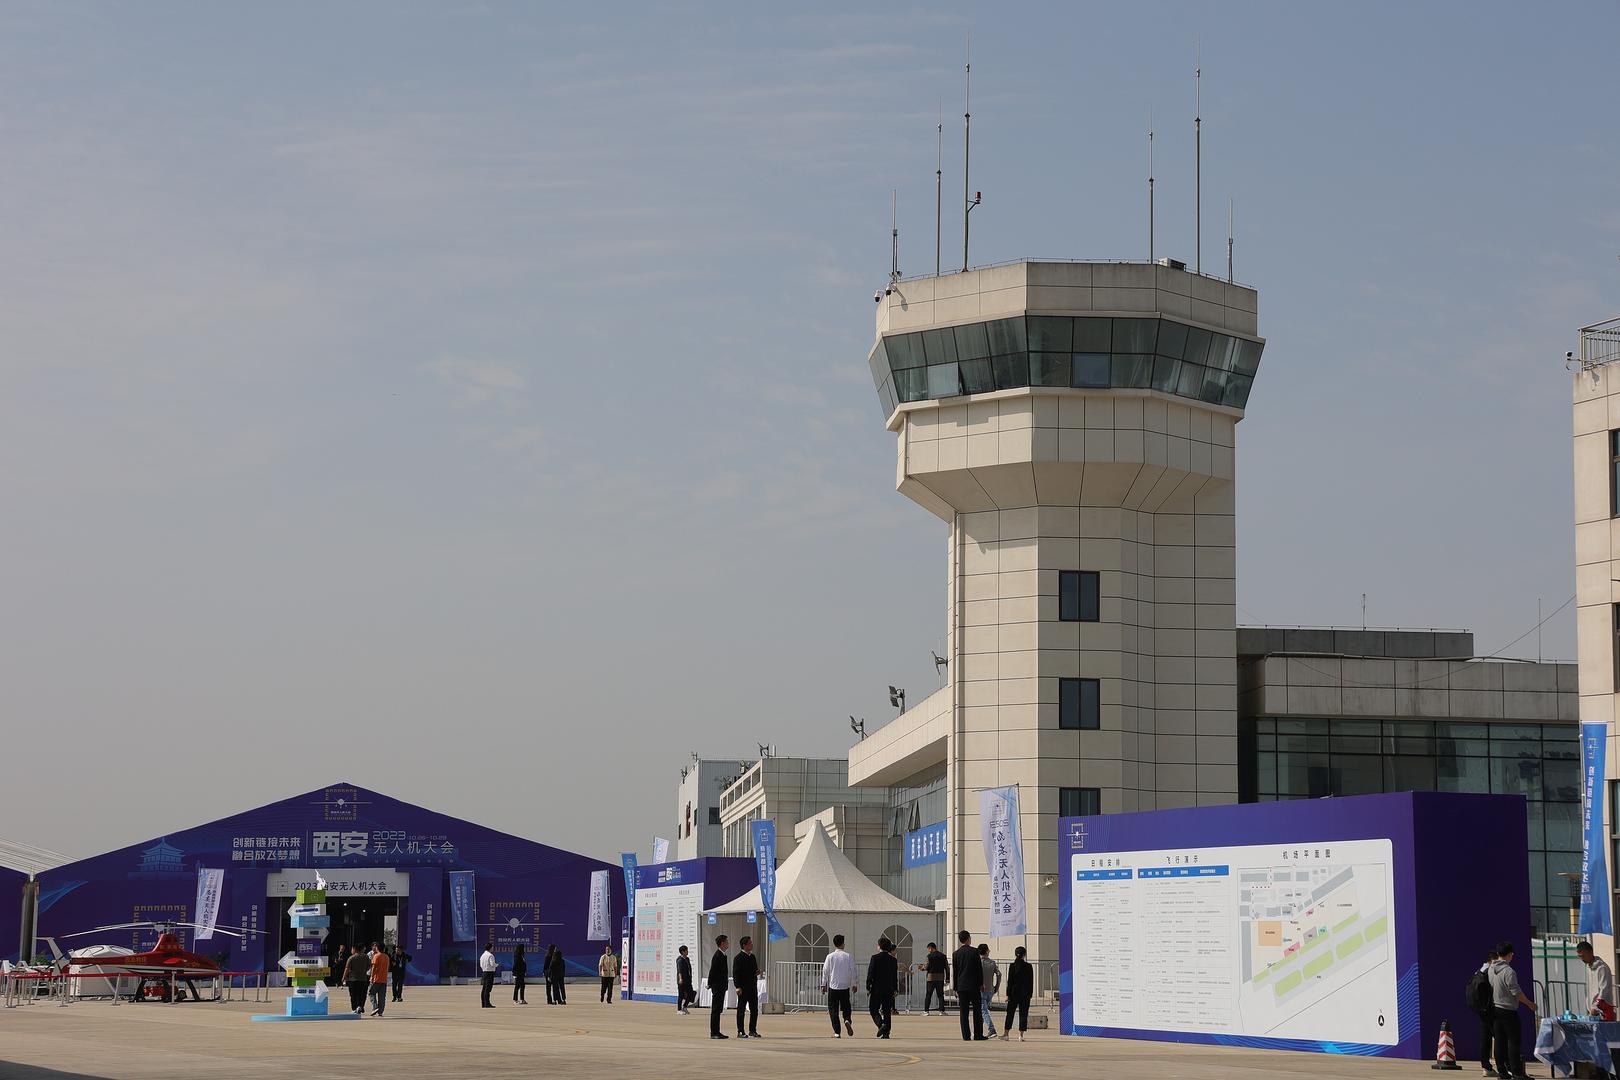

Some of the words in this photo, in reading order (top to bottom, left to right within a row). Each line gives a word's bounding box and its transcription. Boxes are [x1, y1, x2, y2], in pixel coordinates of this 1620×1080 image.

[372, 830, 406, 841] 2023
[233, 837, 301, 848] 创新链接未来
[312, 831, 368, 857] 西安
[373, 841, 454, 854] 无人机大会
[232, 850, 300, 861] 融合放飞梦想
